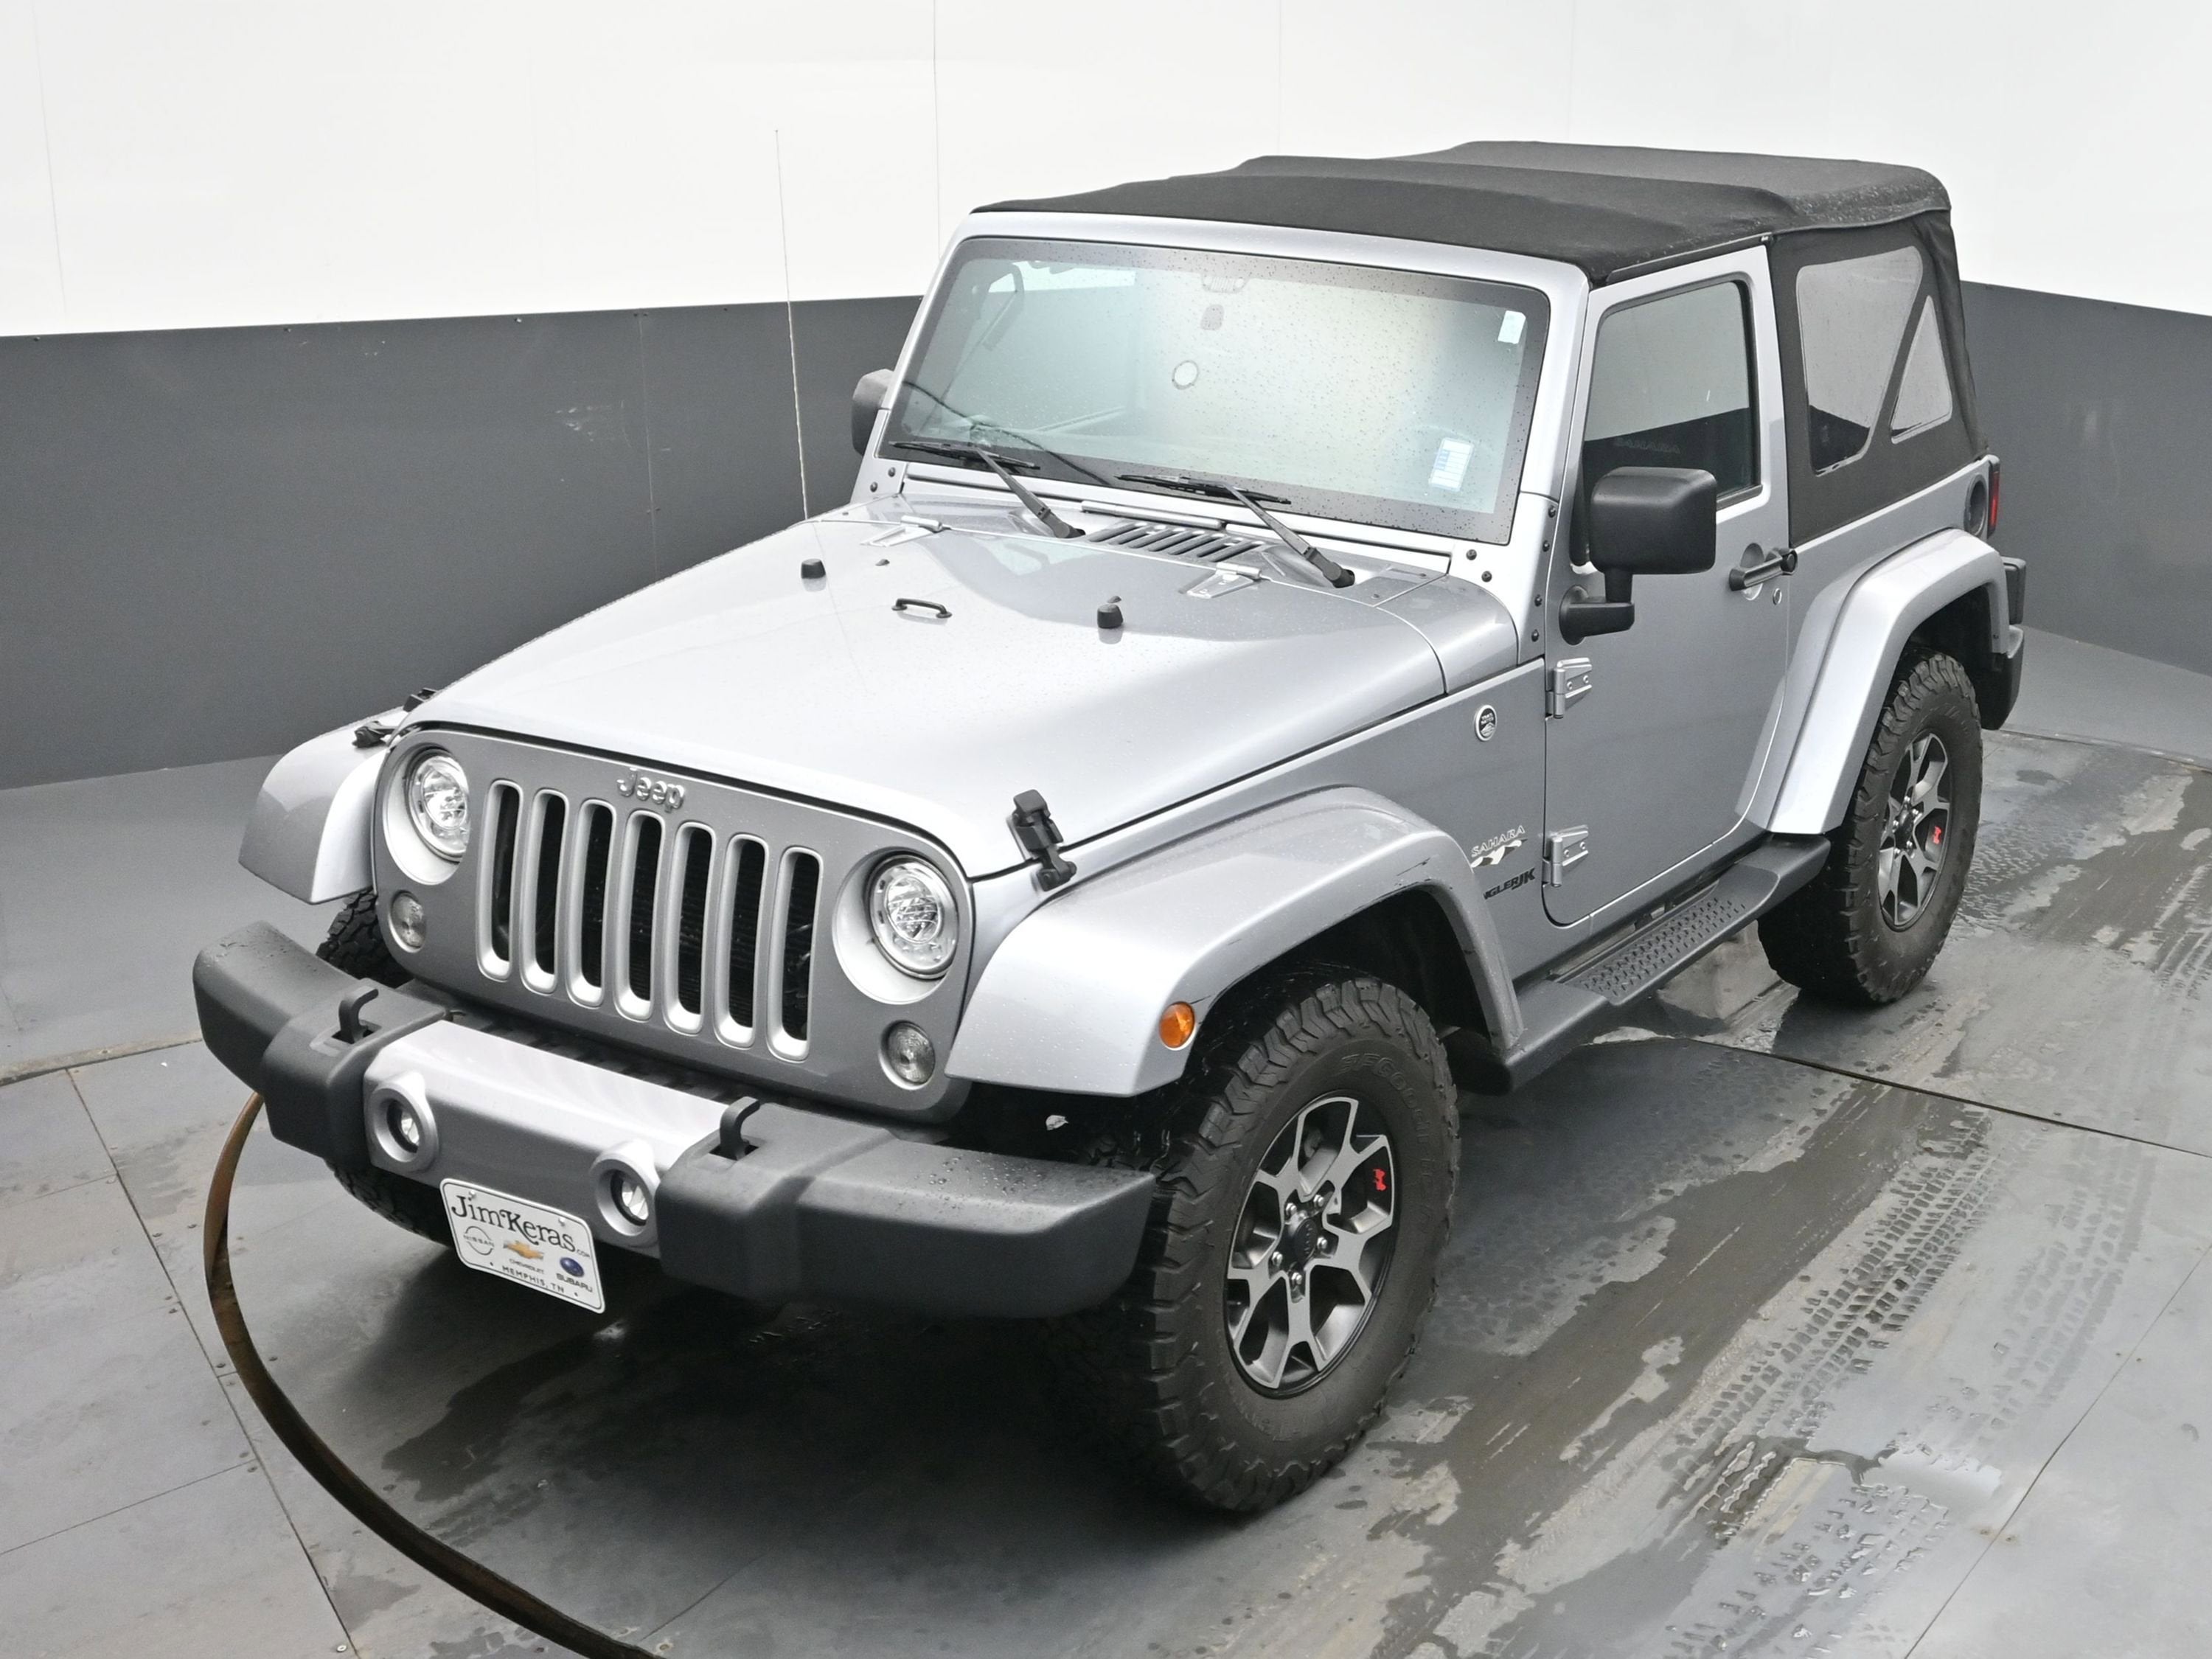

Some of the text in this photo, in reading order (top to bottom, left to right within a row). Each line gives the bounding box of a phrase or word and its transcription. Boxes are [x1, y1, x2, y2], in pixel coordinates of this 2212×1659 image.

[616, 768, 685, 813] Jeep
[1472, 825, 1526, 858] SAHARA
[463, 1234, 495, 1248] NISSAN
[550, 1281, 565, 1293] TN
[556, 1273, 594, 1293] SUBARU
